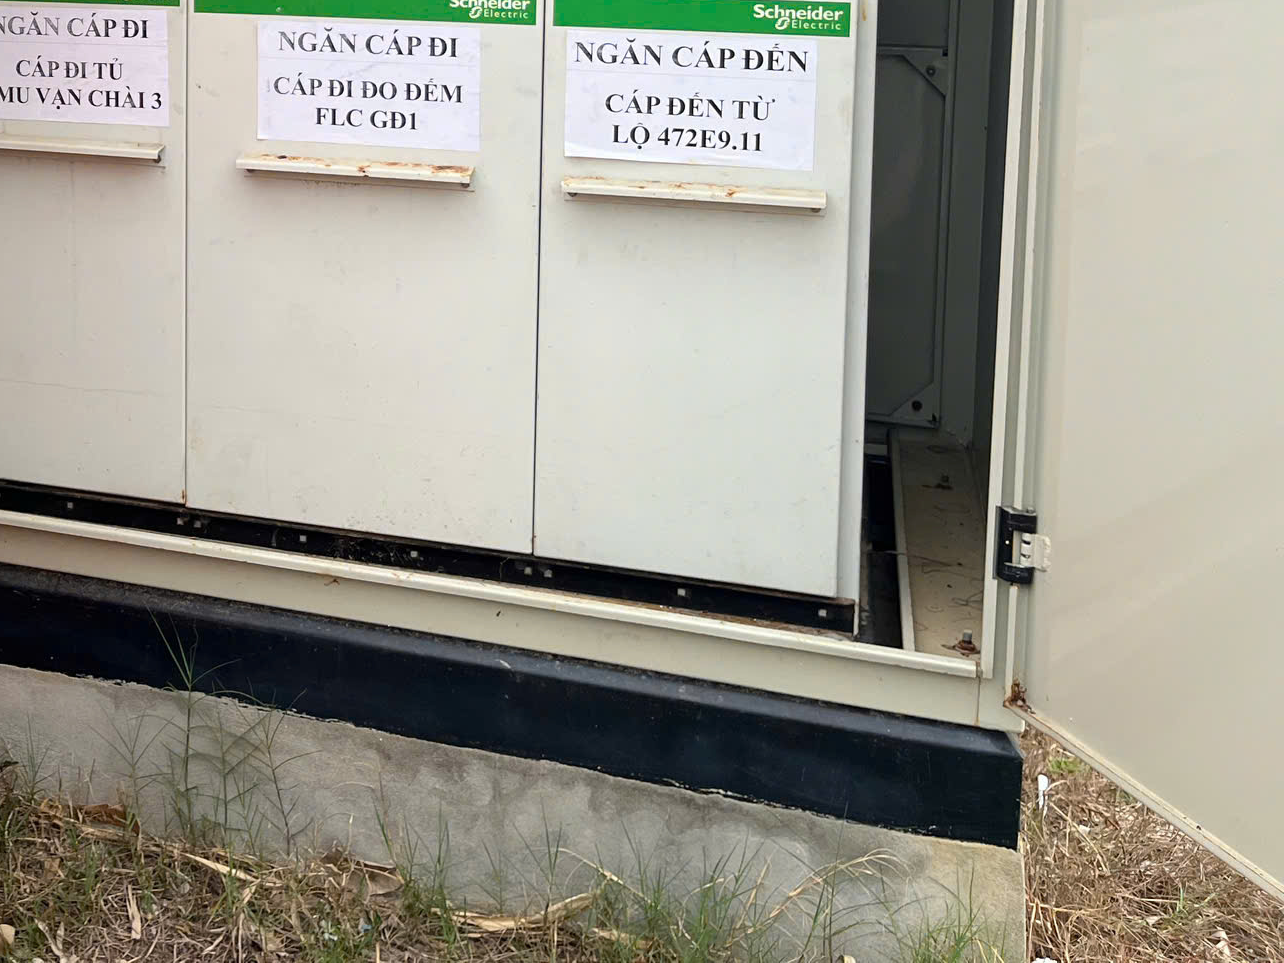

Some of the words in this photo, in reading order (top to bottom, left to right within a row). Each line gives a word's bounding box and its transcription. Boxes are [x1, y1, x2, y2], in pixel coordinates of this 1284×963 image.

[66, 12, 117, 38] CÁP
[121, 19, 149, 39] ĐI
[483, 8, 529, 19] Electric
[753, 4, 844, 21] Schneider
[791, 19, 841, 30] Electric
[278, 27, 357, 53] NGĂN
[365, 29, 422, 56] CÁP
[428, 37, 459, 58] ĐI
[574, 37, 663, 66] NGĂN
[671, 40, 736, 70] CÁP
[741, 42, 809, 72] ĐẾN
[15, 55, 60, 78] CÁP
[63, 61, 88, 79] ĐI
[93, 57, 124, 80] TỦ
[36, 87, 82, 110] VẠN
[88, 85, 145, 109] CHÀI
[151, 92, 162, 110] 3
[273, 72, 323, 96] CÁP
[327, 79, 353, 98] ĐI
[360, 80, 398, 100] ĐO
[404, 77, 463, 103] ĐẾM
[604, 89, 661, 115] CÁP
[666, 92, 725, 119] ĐẾN
[732, 95, 776, 121] TỪ
[315, 107, 364, 127] FLC
[369, 110, 417, 130] GĐ1
[612, 122, 651, 150] LỘ
[657, 128, 762, 152] 472E9.11
